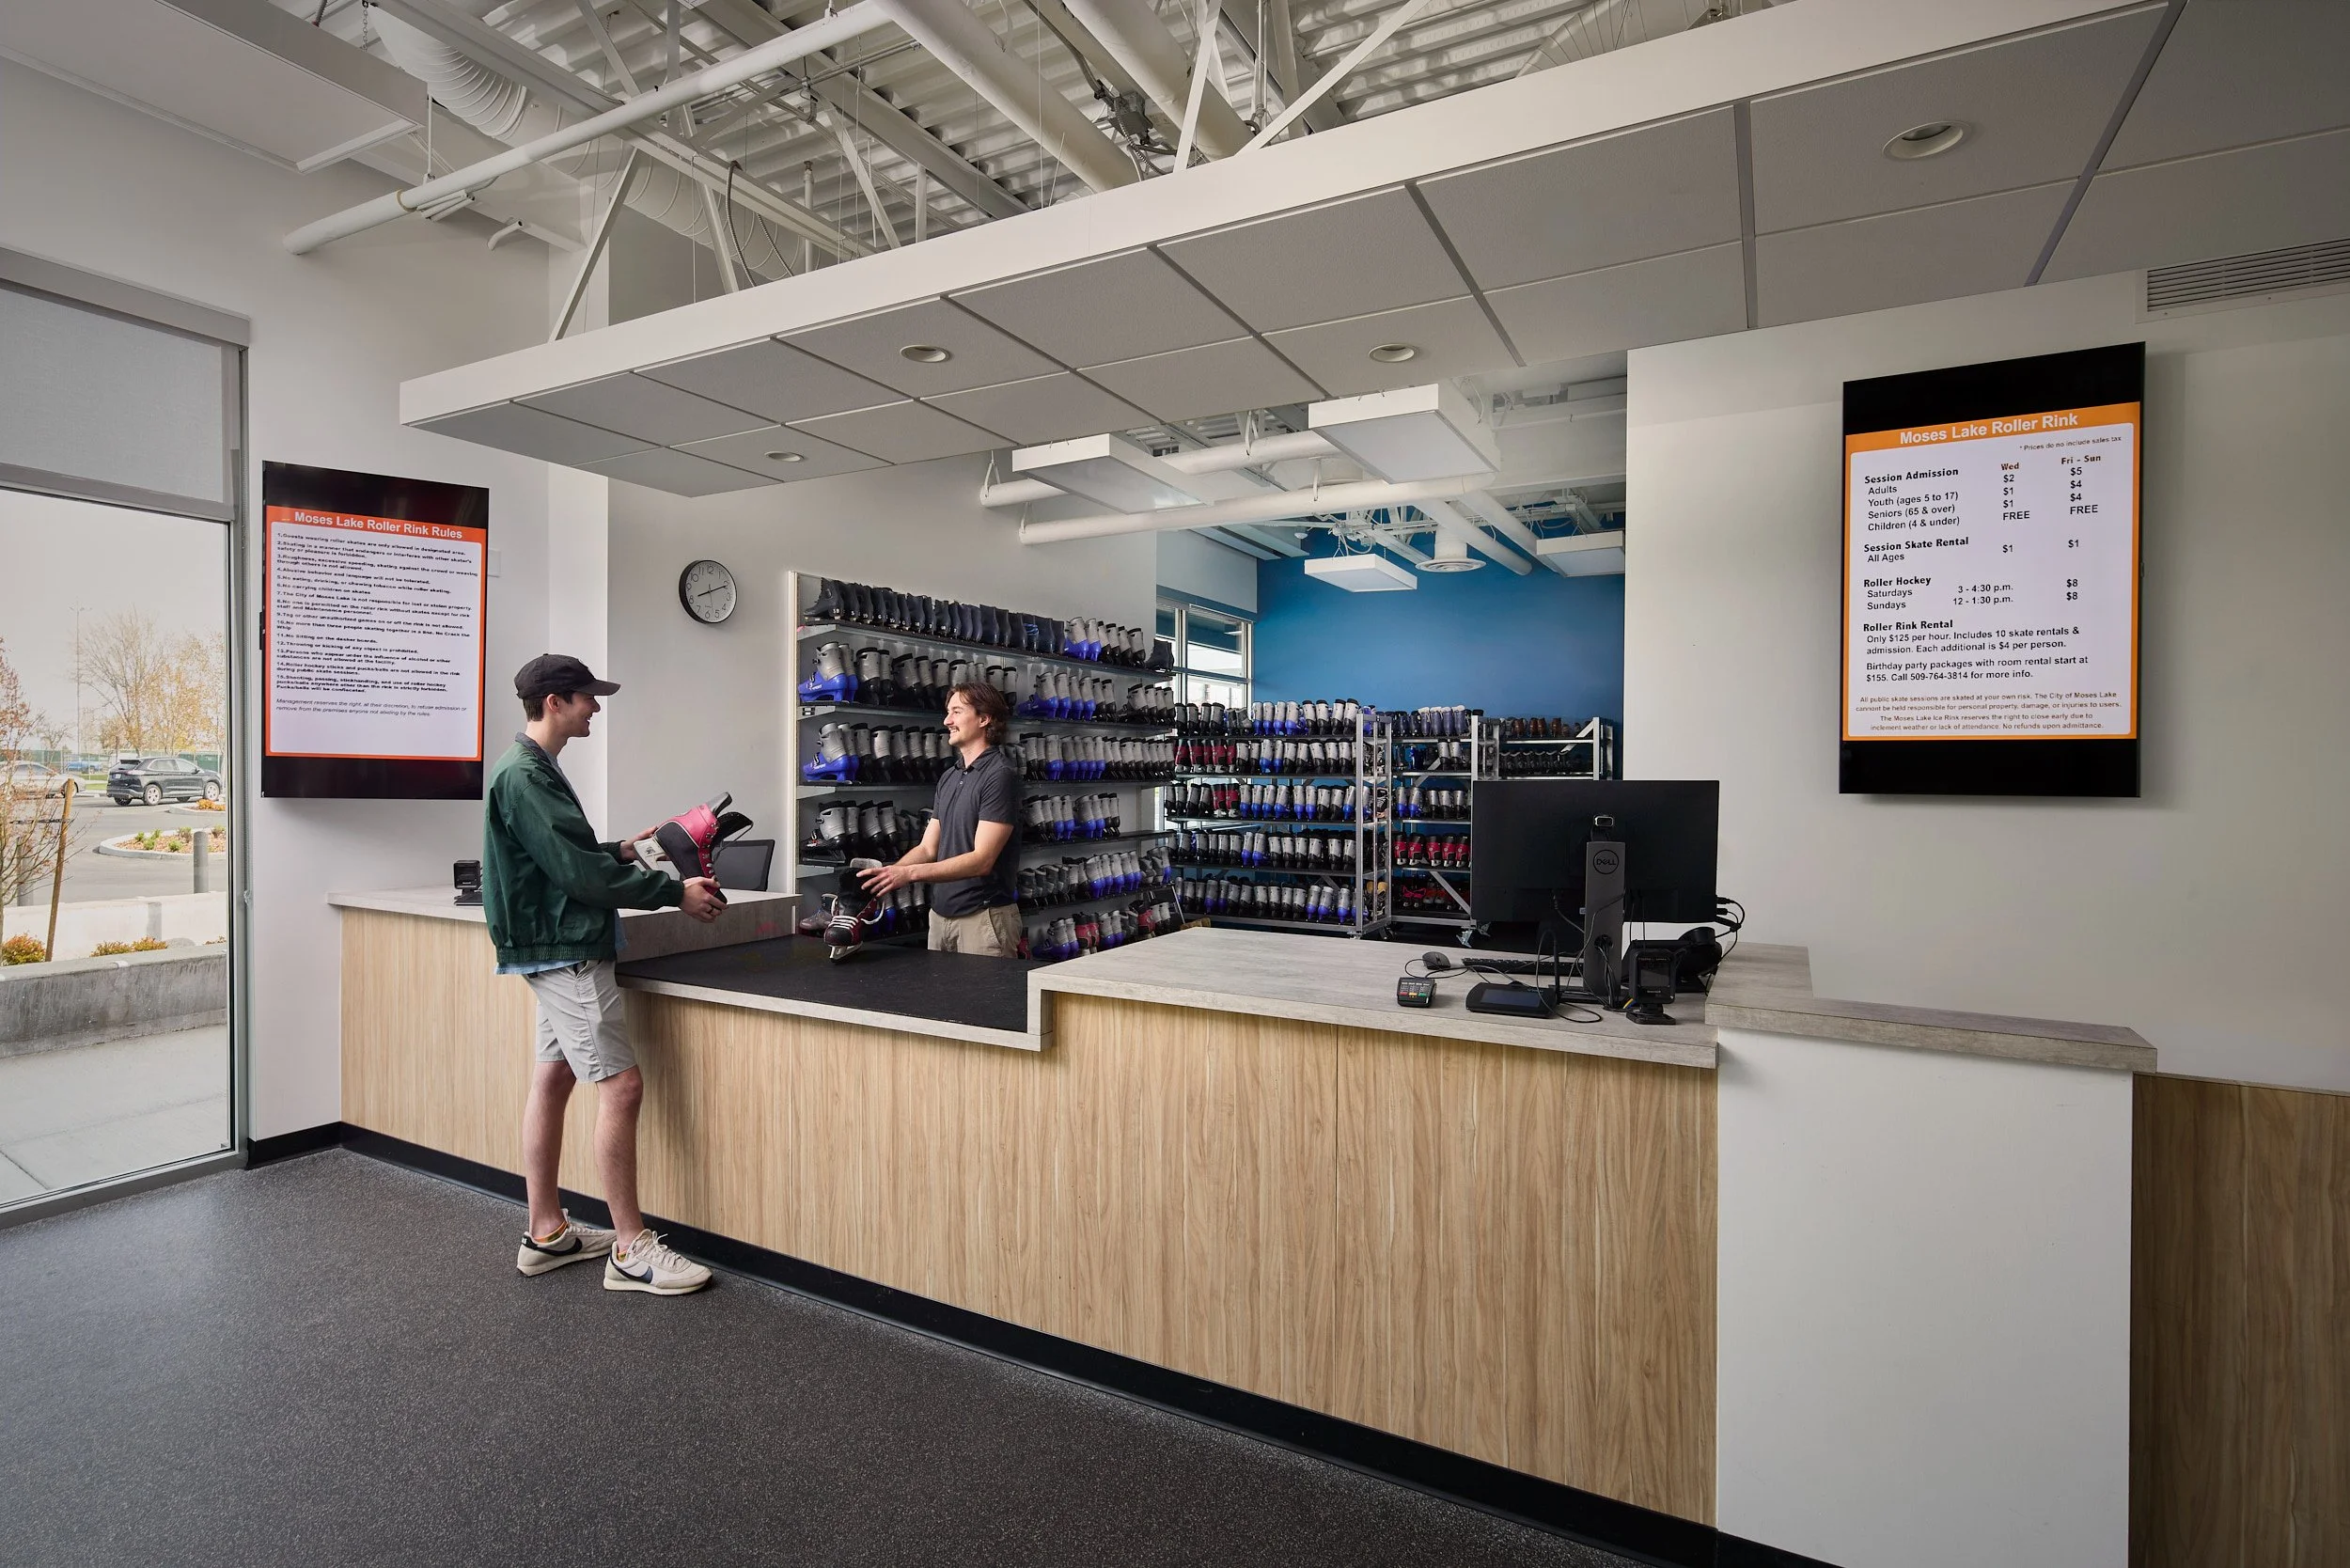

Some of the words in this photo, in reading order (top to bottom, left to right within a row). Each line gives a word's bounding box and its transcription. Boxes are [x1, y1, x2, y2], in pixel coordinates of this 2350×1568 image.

[1900, 430, 1948, 444] Moses
[1951, 424, 1987, 438] Lake
[1991, 418, 2038, 433] Roller
[2042, 413, 2077, 428] Rink
[2060, 456, 2073, 464] Fri
[2000, 462, 2019, 470] Wed
[2070, 466, 2082, 476] $5
[1864, 474, 1902, 483] Session
[1905, 468, 1958, 479] Admission
[2002, 474, 2013, 482] $2
[2070, 479, 2082, 489] $4
[1867, 485, 1897, 494] Adults
[2002, 487, 2013, 495] $1
[1868, 497, 1893, 506] Youth
[1896, 496, 1921, 506] (ages
[1944, 491, 1958, 500] 17)
[2070, 493, 2081, 502] $4
[2002, 499, 2013, 508] $1
[1868, 510, 1902, 519] Seniors
[1904, 507, 1919, 517] (65
[1921, 506, 1928, 514] &
[1931, 504, 1954, 513] over)
[2069, 504, 2098, 514] FREE
[2002, 510, 2029, 520] FREE
[294, 511, 333, 525] Moses
[337, 516, 364, 528] Lake
[367, 519, 400, 532] Roller
[404, 524, 429, 536] Rink
[432, 526, 462, 539] Rules
[1867, 522, 1905, 530] Children
[1908, 519, 1917, 529] (4
[1919, 518, 1926, 526] &
[1929, 516, 1959, 525] under)
[1863, 542, 1901, 552] Session
[1904, 541, 1933, 549] Skate
[1935, 536, 1968, 546] Rental
[2002, 544, 2013, 553] $1
[2067, 539, 2078, 548] $1
[1867, 554, 1879, 562] All
[1881, 553, 1904, 562] Ages
[1863, 578, 1892, 587] Roller
[1895, 575, 1931, 586] Hockey
[2066, 578, 2077, 588] $8
[1867, 588, 1912, 597] Saturdays
[1957, 585, 1963, 593] 3
[1993, 584, 2013, 592] p.m.
[1971, 595, 1991, 604] 1:30
[1993, 596, 2013, 604] p.m.
[2066, 591, 2077, 601] $8
[1867, 601, 1906, 610] Sundays
[1863, 622, 1892, 631] Roller
[1895, 620, 1917, 630] Rink
[1920, 619, 1952, 628] Rental
[1866, 635, 1886, 644] Only
[1888, 634, 1909, 642] $125
[1995, 629, 2006, 637] 10
[2036, 627, 2069, 635] rentals
[1916, 644, 1937, 652] Each
[1940, 642, 1985, 651] additional
[1998, 641, 2009, 650] $4
[2012, 642, 2028, 651] per
[2029, 641, 2066, 650] person.
[1866, 662, 1903, 670] Birthday
[1904, 662, 1927, 670] party
[1930, 660, 1972, 669] packages
[2024, 656, 2051, 665] rental
[1866, 673, 1888, 682] $155.
[1910, 671, 1967, 680] 509-764-3814
[1970, 670, 1983, 679] for
